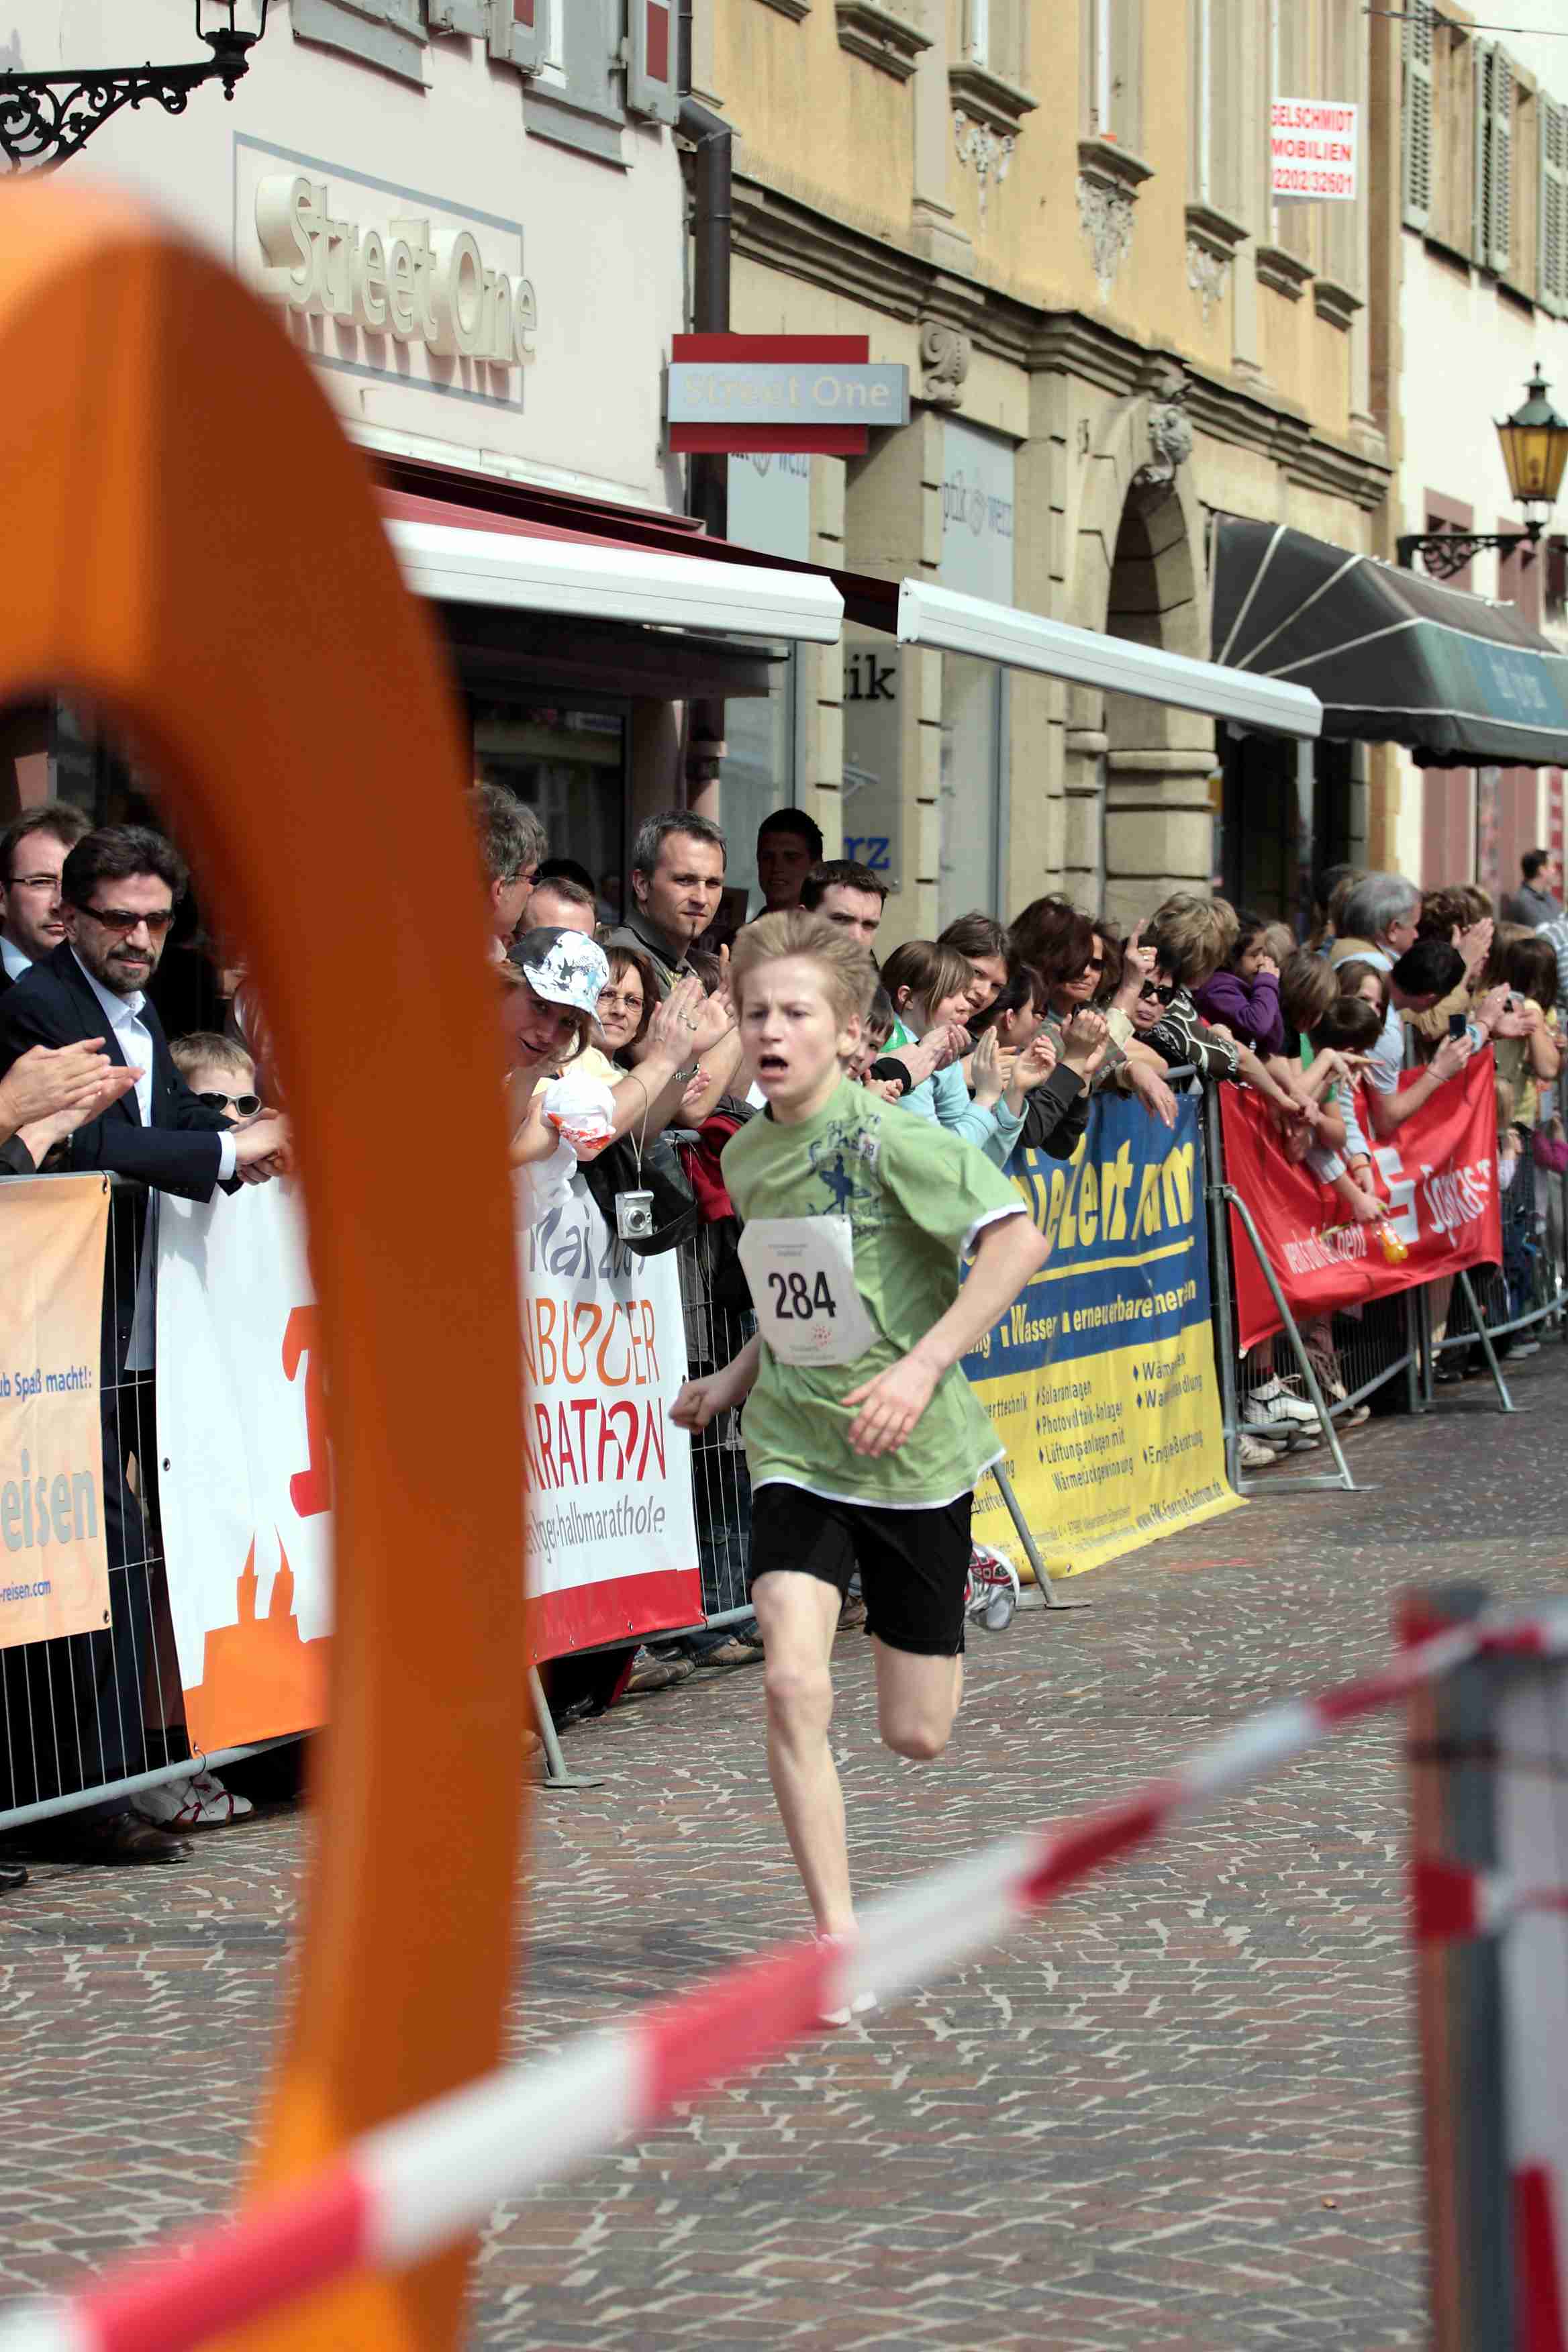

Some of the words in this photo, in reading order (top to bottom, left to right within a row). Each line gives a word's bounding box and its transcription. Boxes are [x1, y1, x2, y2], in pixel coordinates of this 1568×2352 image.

[256, 176, 438, 343] Street
[428, 227, 538, 368] One
[683, 373, 801, 408] Street
[810, 374, 891, 408] One
[768, 1270, 836, 1320] 284
[1010, 1303, 1059, 1346] Wasser
[15, 1369, 42, 1402] Spaß
[1, 1448, 97, 1552] eisen
